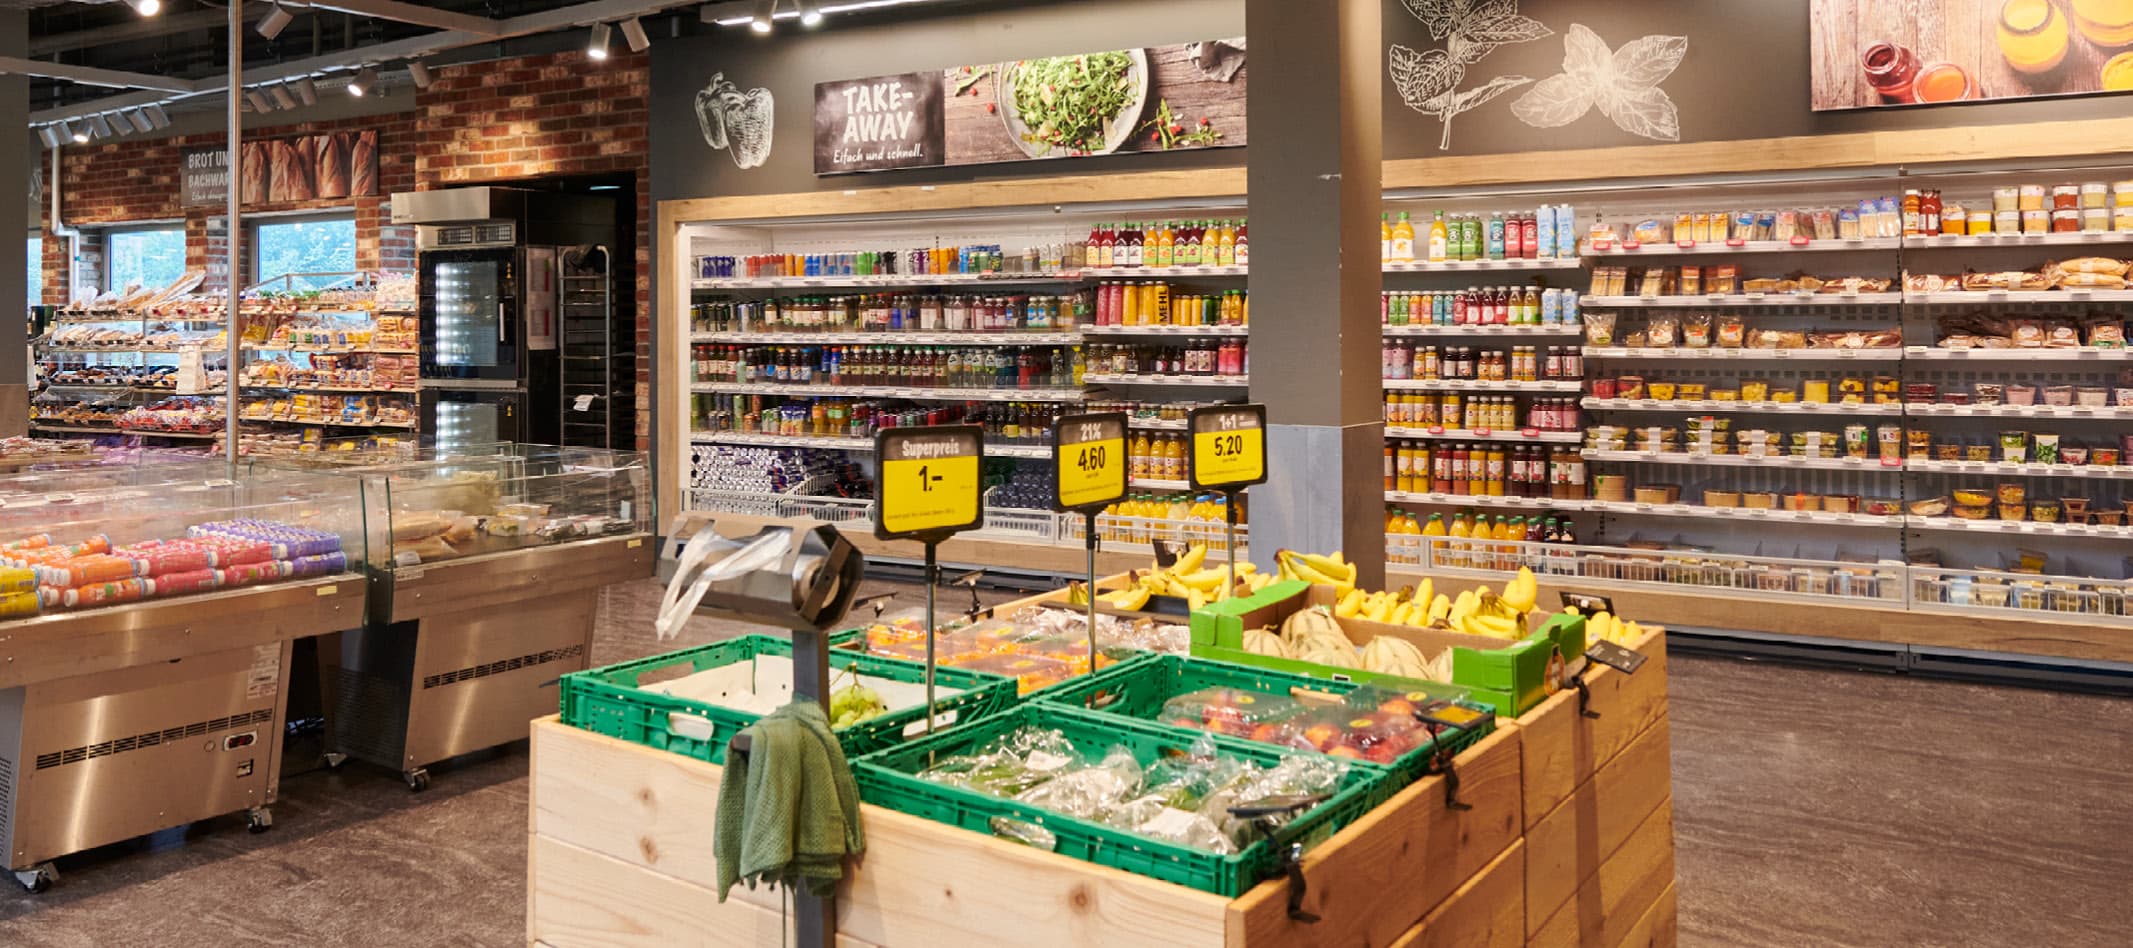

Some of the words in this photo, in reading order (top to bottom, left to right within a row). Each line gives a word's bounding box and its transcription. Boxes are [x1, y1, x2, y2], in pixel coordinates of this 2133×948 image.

[843, 82, 913, 114] TAKE-
[843, 111, 914, 144] AWAY
[188, 152, 214, 168] BROT
[833, 148, 864, 165] Eifach
[866, 146, 884, 161] und
[887, 143, 924, 160] schnell.
[1080, 423, 1102, 442] 21%
[1219, 414, 1237, 430] 1+1
[902, 437, 960, 459] Superpreis
[1214, 435, 1242, 457] 5.20
[1077, 445, 1106, 472] 4.60
[918, 465, 943, 492] 1.-
